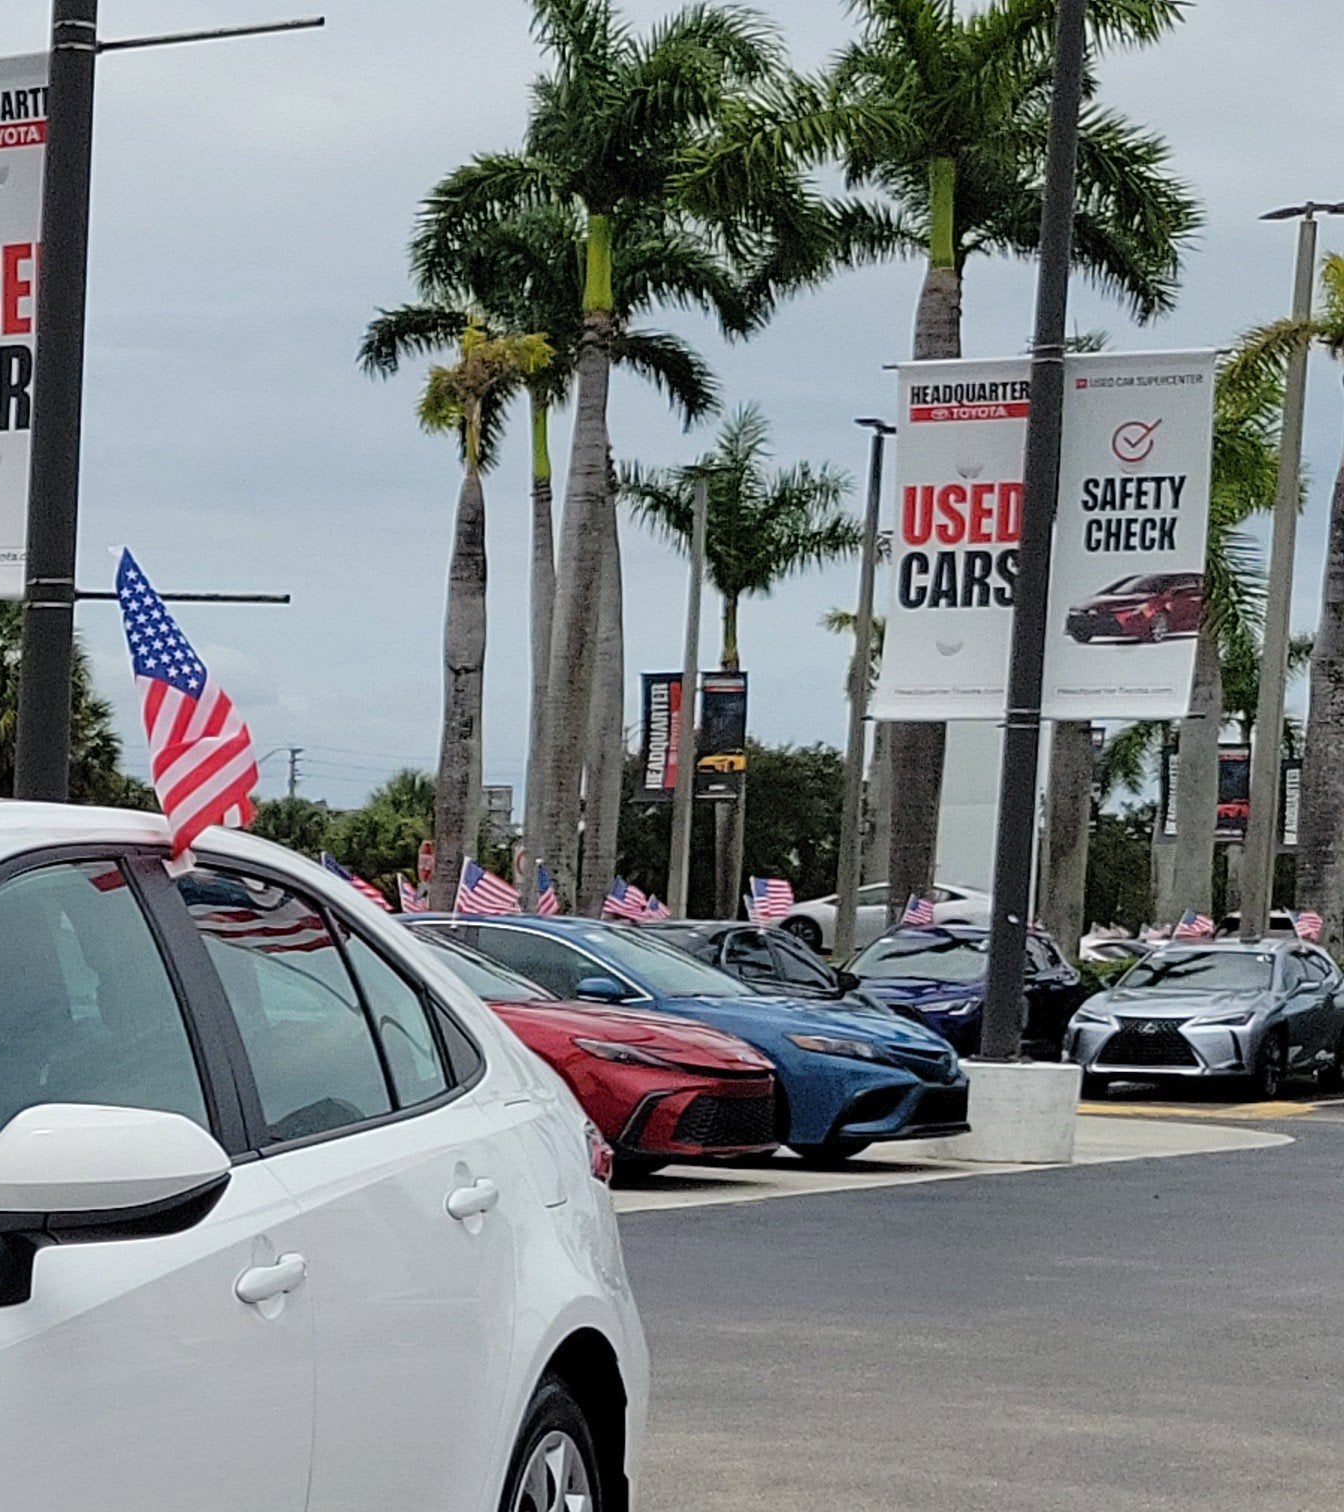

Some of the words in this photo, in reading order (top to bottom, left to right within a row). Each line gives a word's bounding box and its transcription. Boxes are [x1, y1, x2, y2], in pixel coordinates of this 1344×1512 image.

[910, 381, 1031, 406] HEADQUARTER
[952, 406, 1009, 419] TOYOTA
[1081, 475, 1187, 512] SAFETY
[902, 482, 1024, 546] USED
[1085, 516, 1178, 552] CHECK
[898, 548, 1020, 609] CARS
